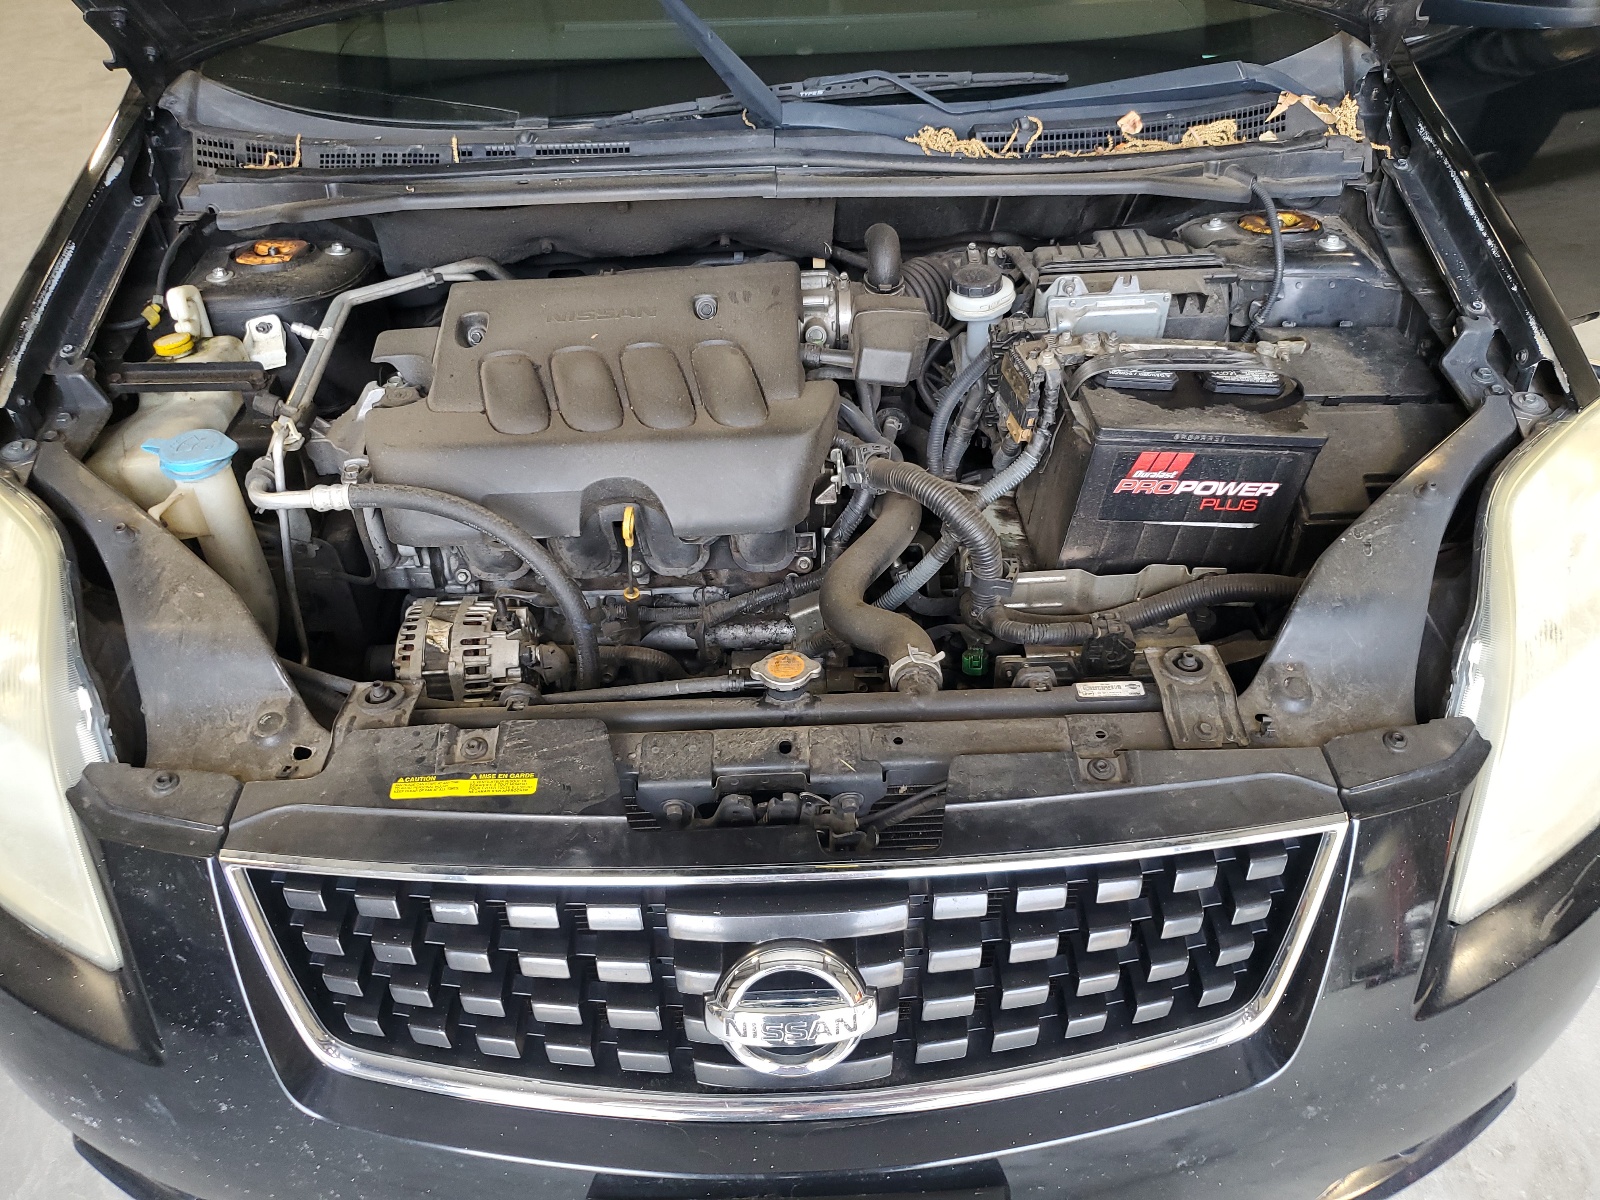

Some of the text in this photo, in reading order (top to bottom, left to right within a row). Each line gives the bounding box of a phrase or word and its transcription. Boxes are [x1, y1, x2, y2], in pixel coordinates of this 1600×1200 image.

[546, 306, 657, 323] NISSAN
[1132, 470, 1178, 479] Duralast
[1199, 498, 1259, 512] PLUS
[723, 1014, 858, 1041] NISSAN
